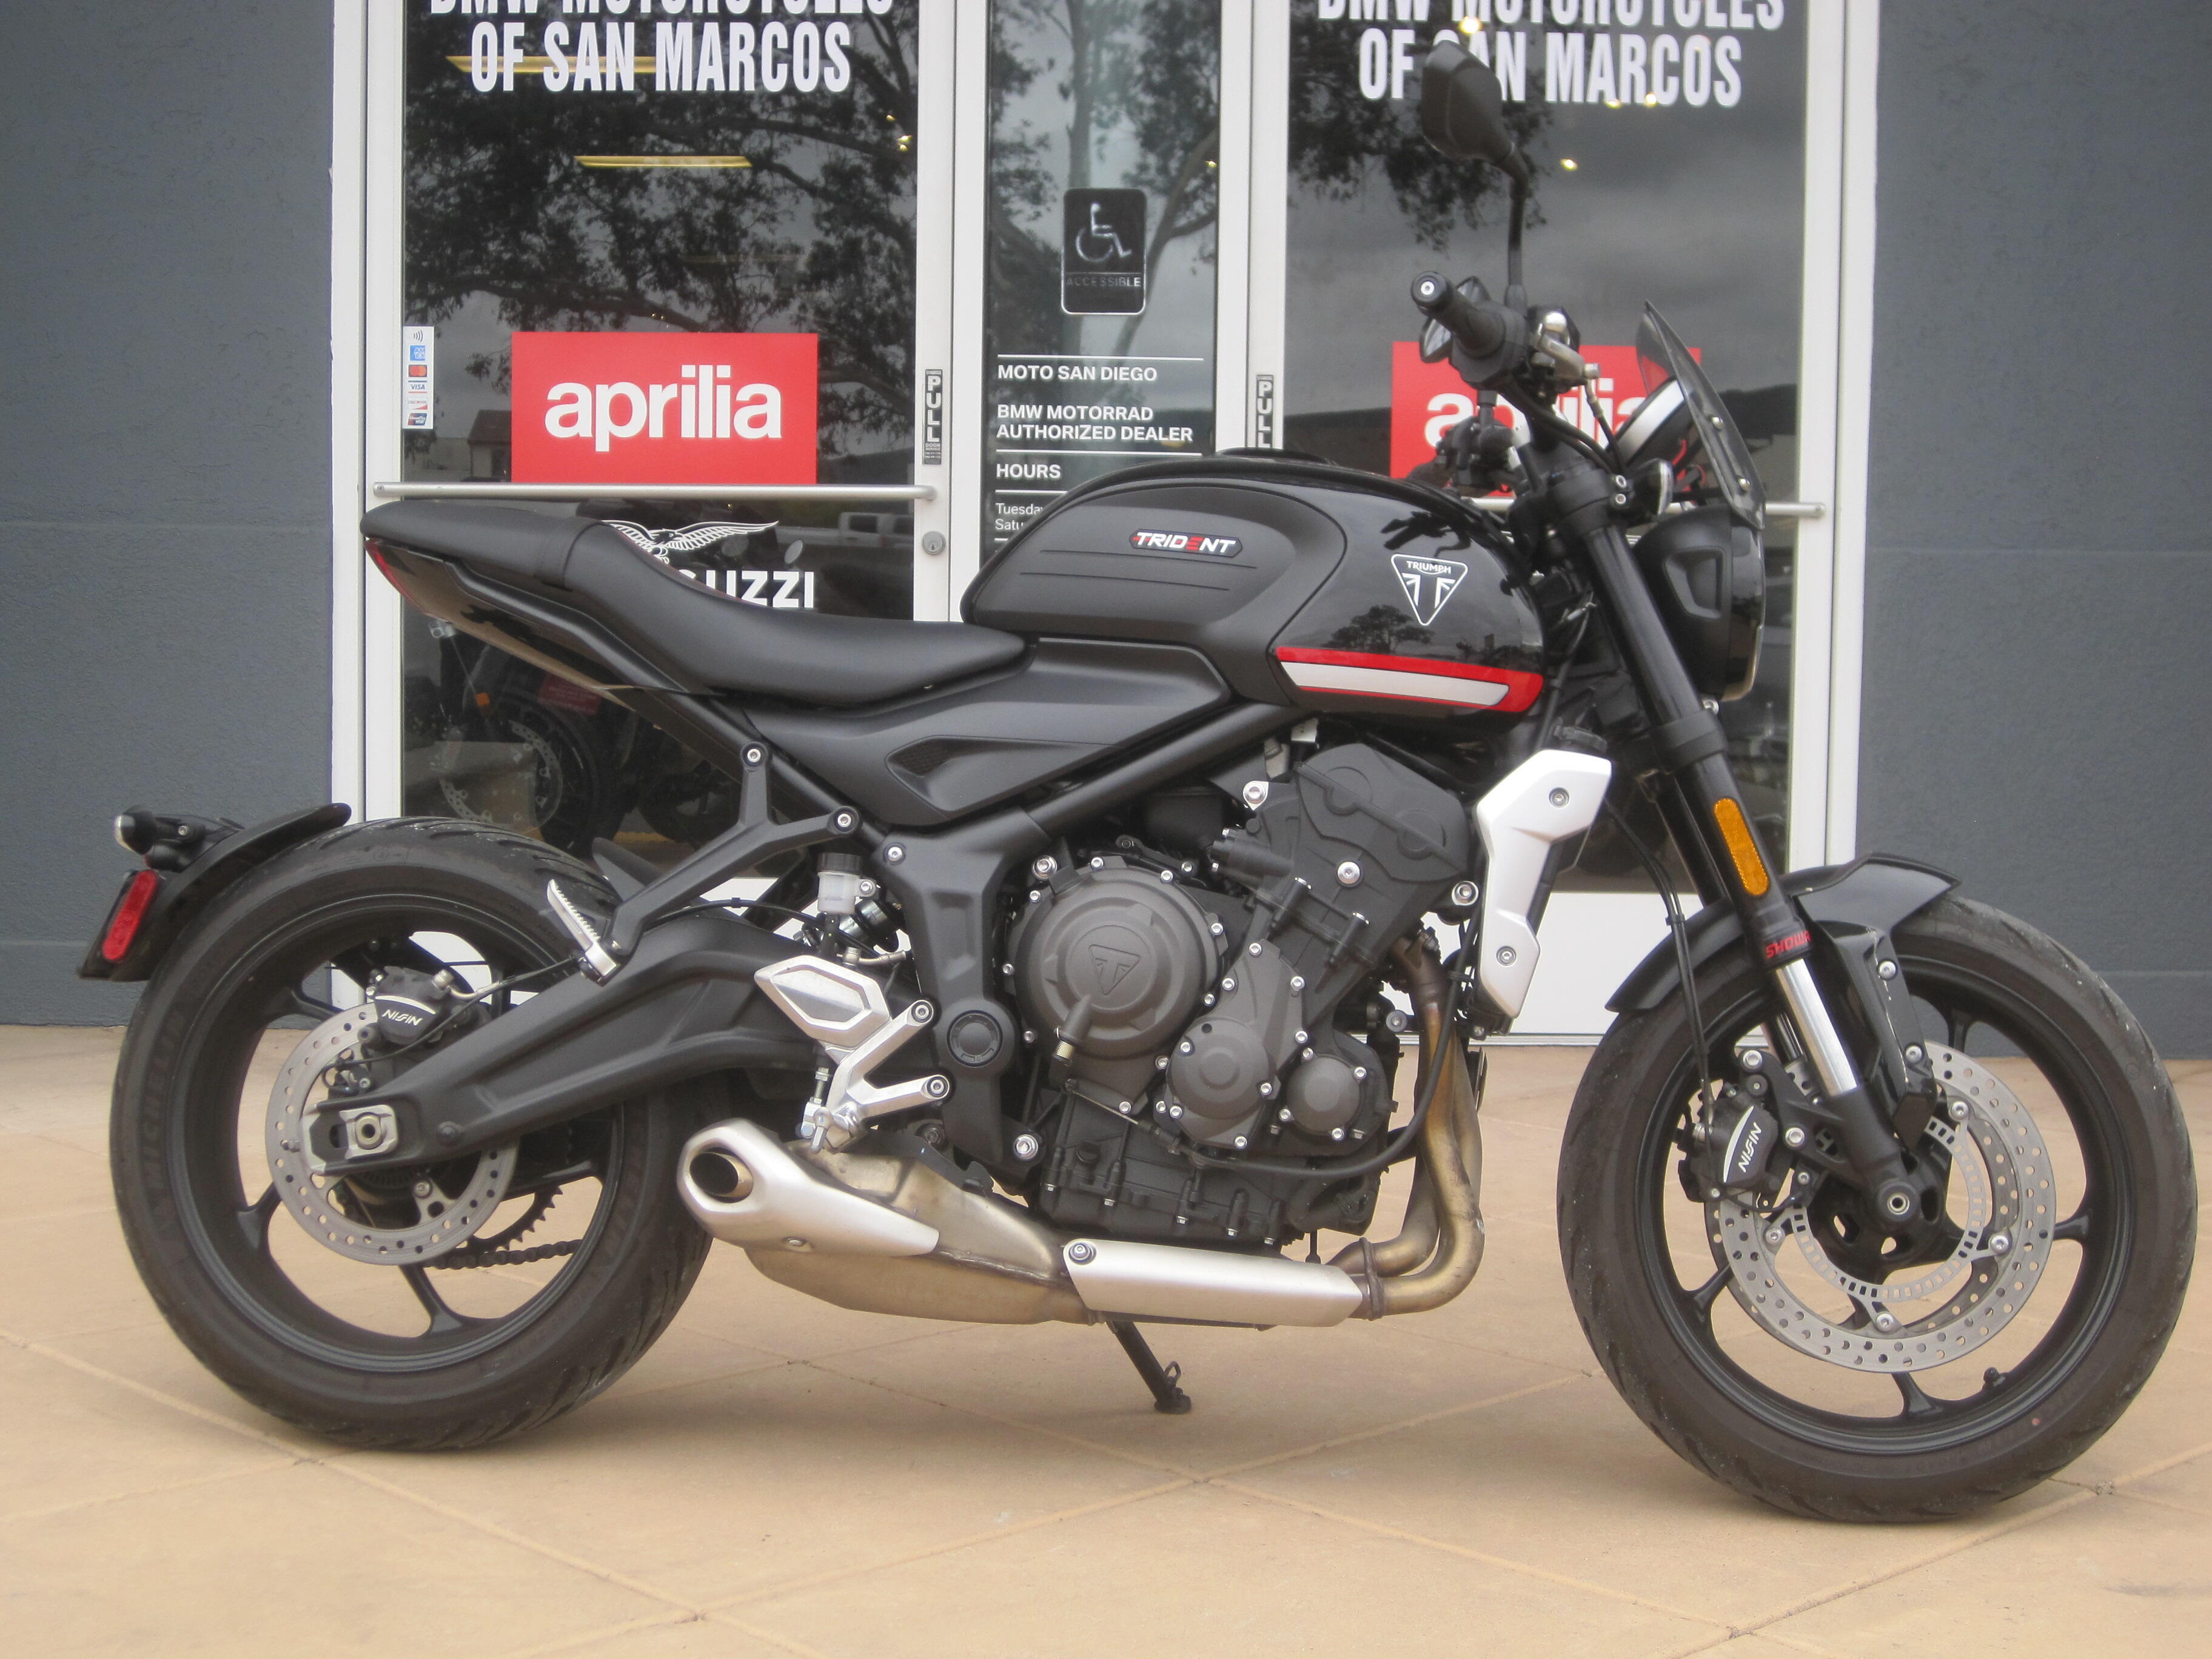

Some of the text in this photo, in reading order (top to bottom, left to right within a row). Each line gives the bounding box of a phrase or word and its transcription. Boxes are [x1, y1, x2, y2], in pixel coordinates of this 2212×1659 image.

[471, 21, 851, 92] OF SAN MARCOS
[1359, 28, 1415, 101] OF
[1544, 32, 1742, 107] MARCOS
[1067, 277, 1141, 287] ACCESSIBLE
[997, 365, 1158, 381] MOTO SAN DIEGO
[545, 365, 782, 452] aprilia
[926, 375, 941, 442] PULL
[997, 404, 1153, 420] BMW MOTORRAD
[1258, 381, 1272, 447] PULL
[996, 424, 1193, 441] AUTHORIZED DEALER
[996, 464, 1061, 478] HOURS
[995, 503, 1043, 515] Tuesda
[1136, 532, 1236, 553] TRIDENT
[1406, 560, 1452, 575] TRIUMPH
[1766, 930, 1812, 959] SHOWA
